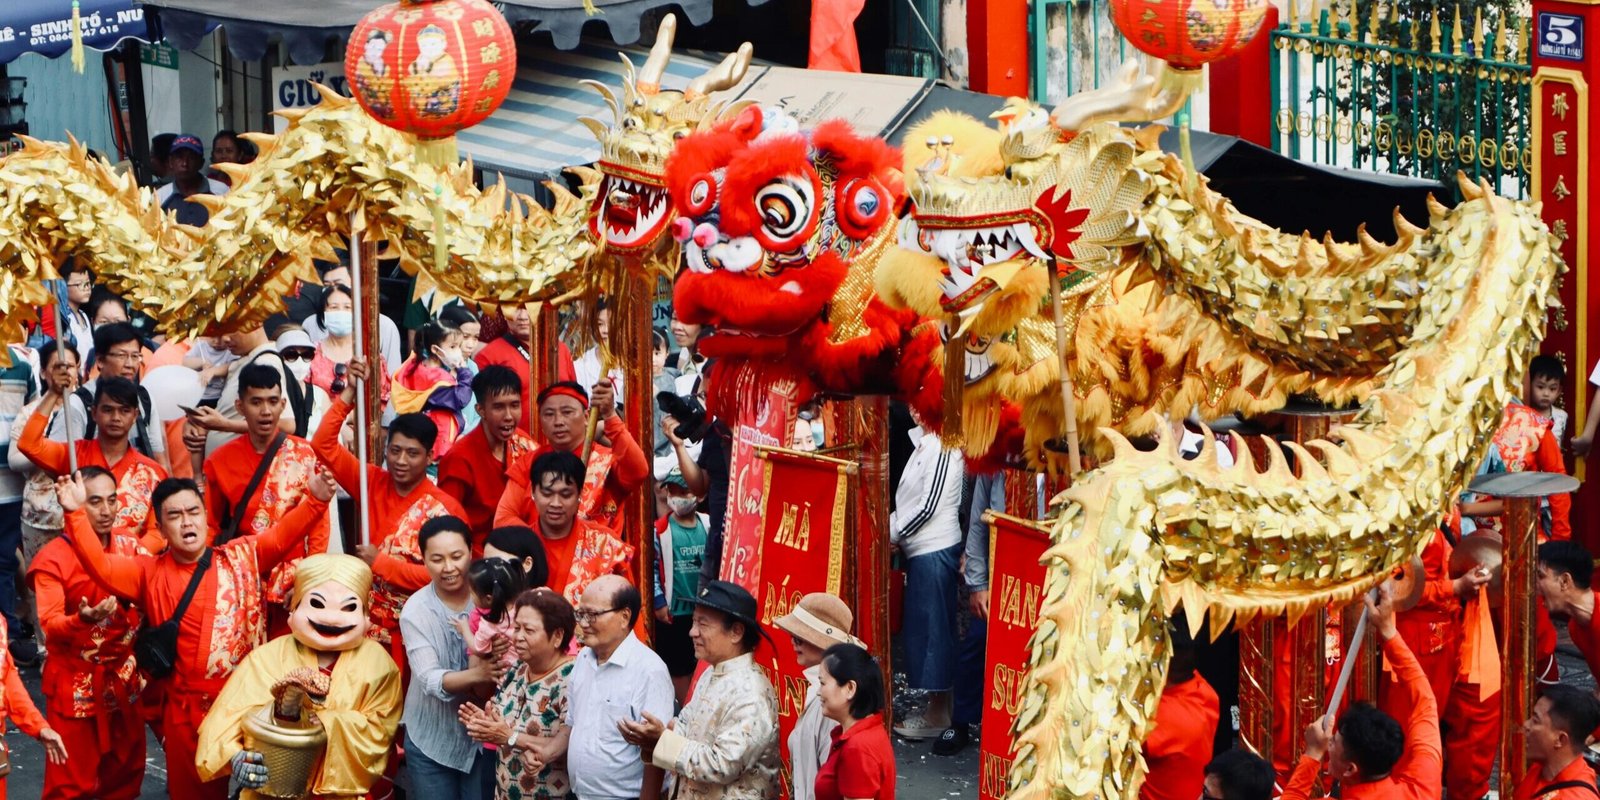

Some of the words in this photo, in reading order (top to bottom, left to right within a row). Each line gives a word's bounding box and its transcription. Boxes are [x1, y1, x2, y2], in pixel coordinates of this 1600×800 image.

[30, 19, 73, 37] SINH
[1546, 16, 1577, 45] 5
[279, 71, 324, 107] GIỮ
[330, 76, 354, 98] X
[774, 501, 811, 552] MÃ
[999, 573, 1041, 631] VẠN
[982, 750, 1012, 800] NH
